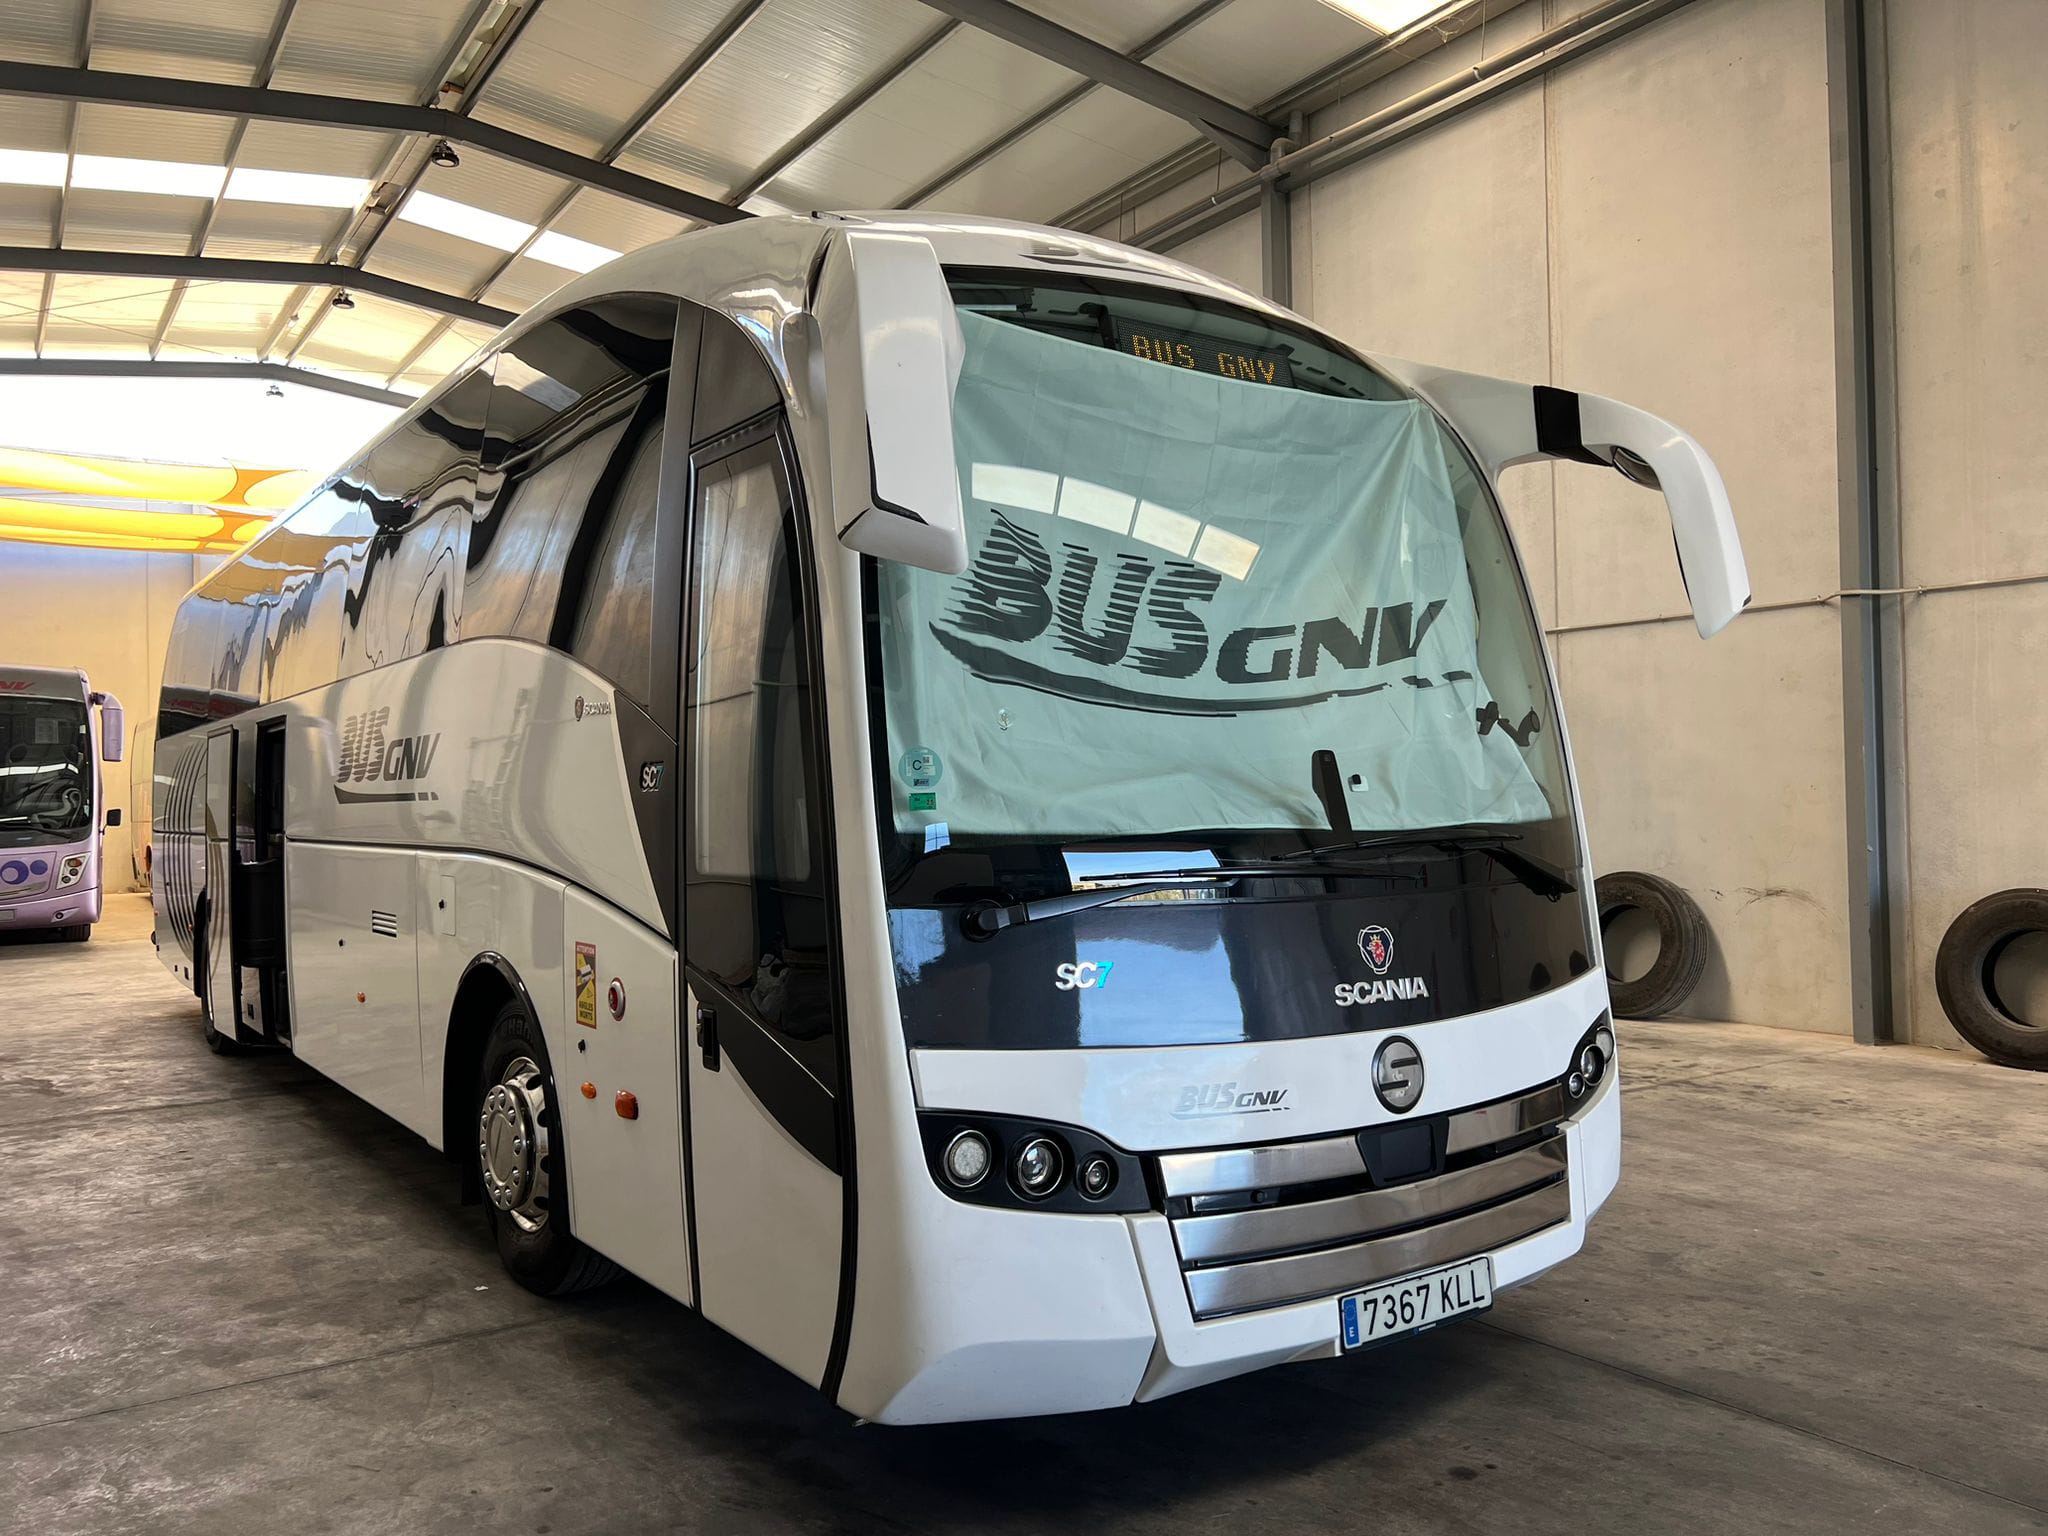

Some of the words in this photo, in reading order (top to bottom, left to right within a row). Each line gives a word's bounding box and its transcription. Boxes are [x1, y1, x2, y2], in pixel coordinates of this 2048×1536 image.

[1132, 334, 1195, 369] BUS
[1217, 352, 1276, 384] GNV
[940, 508, 1222, 680] BUS
[1216, 599, 1448, 684] GNV
[583, 702, 613, 716] SCANIA
[383, 732, 442, 782] GNV
[912, 759, 922, 771] C
[642, 765, 664, 788] SC7
[1055, 961, 1115, 992] SC7
[1334, 976, 1430, 1007] SCANIA
[1175, 1082, 1237, 1113] BUS
[1235, 1089, 1288, 1108] GNV
[1348, 1326, 1356, 1338] E
[1363, 1283, 1430, 1336] 7367
[1440, 1269, 1486, 1314] KLL
